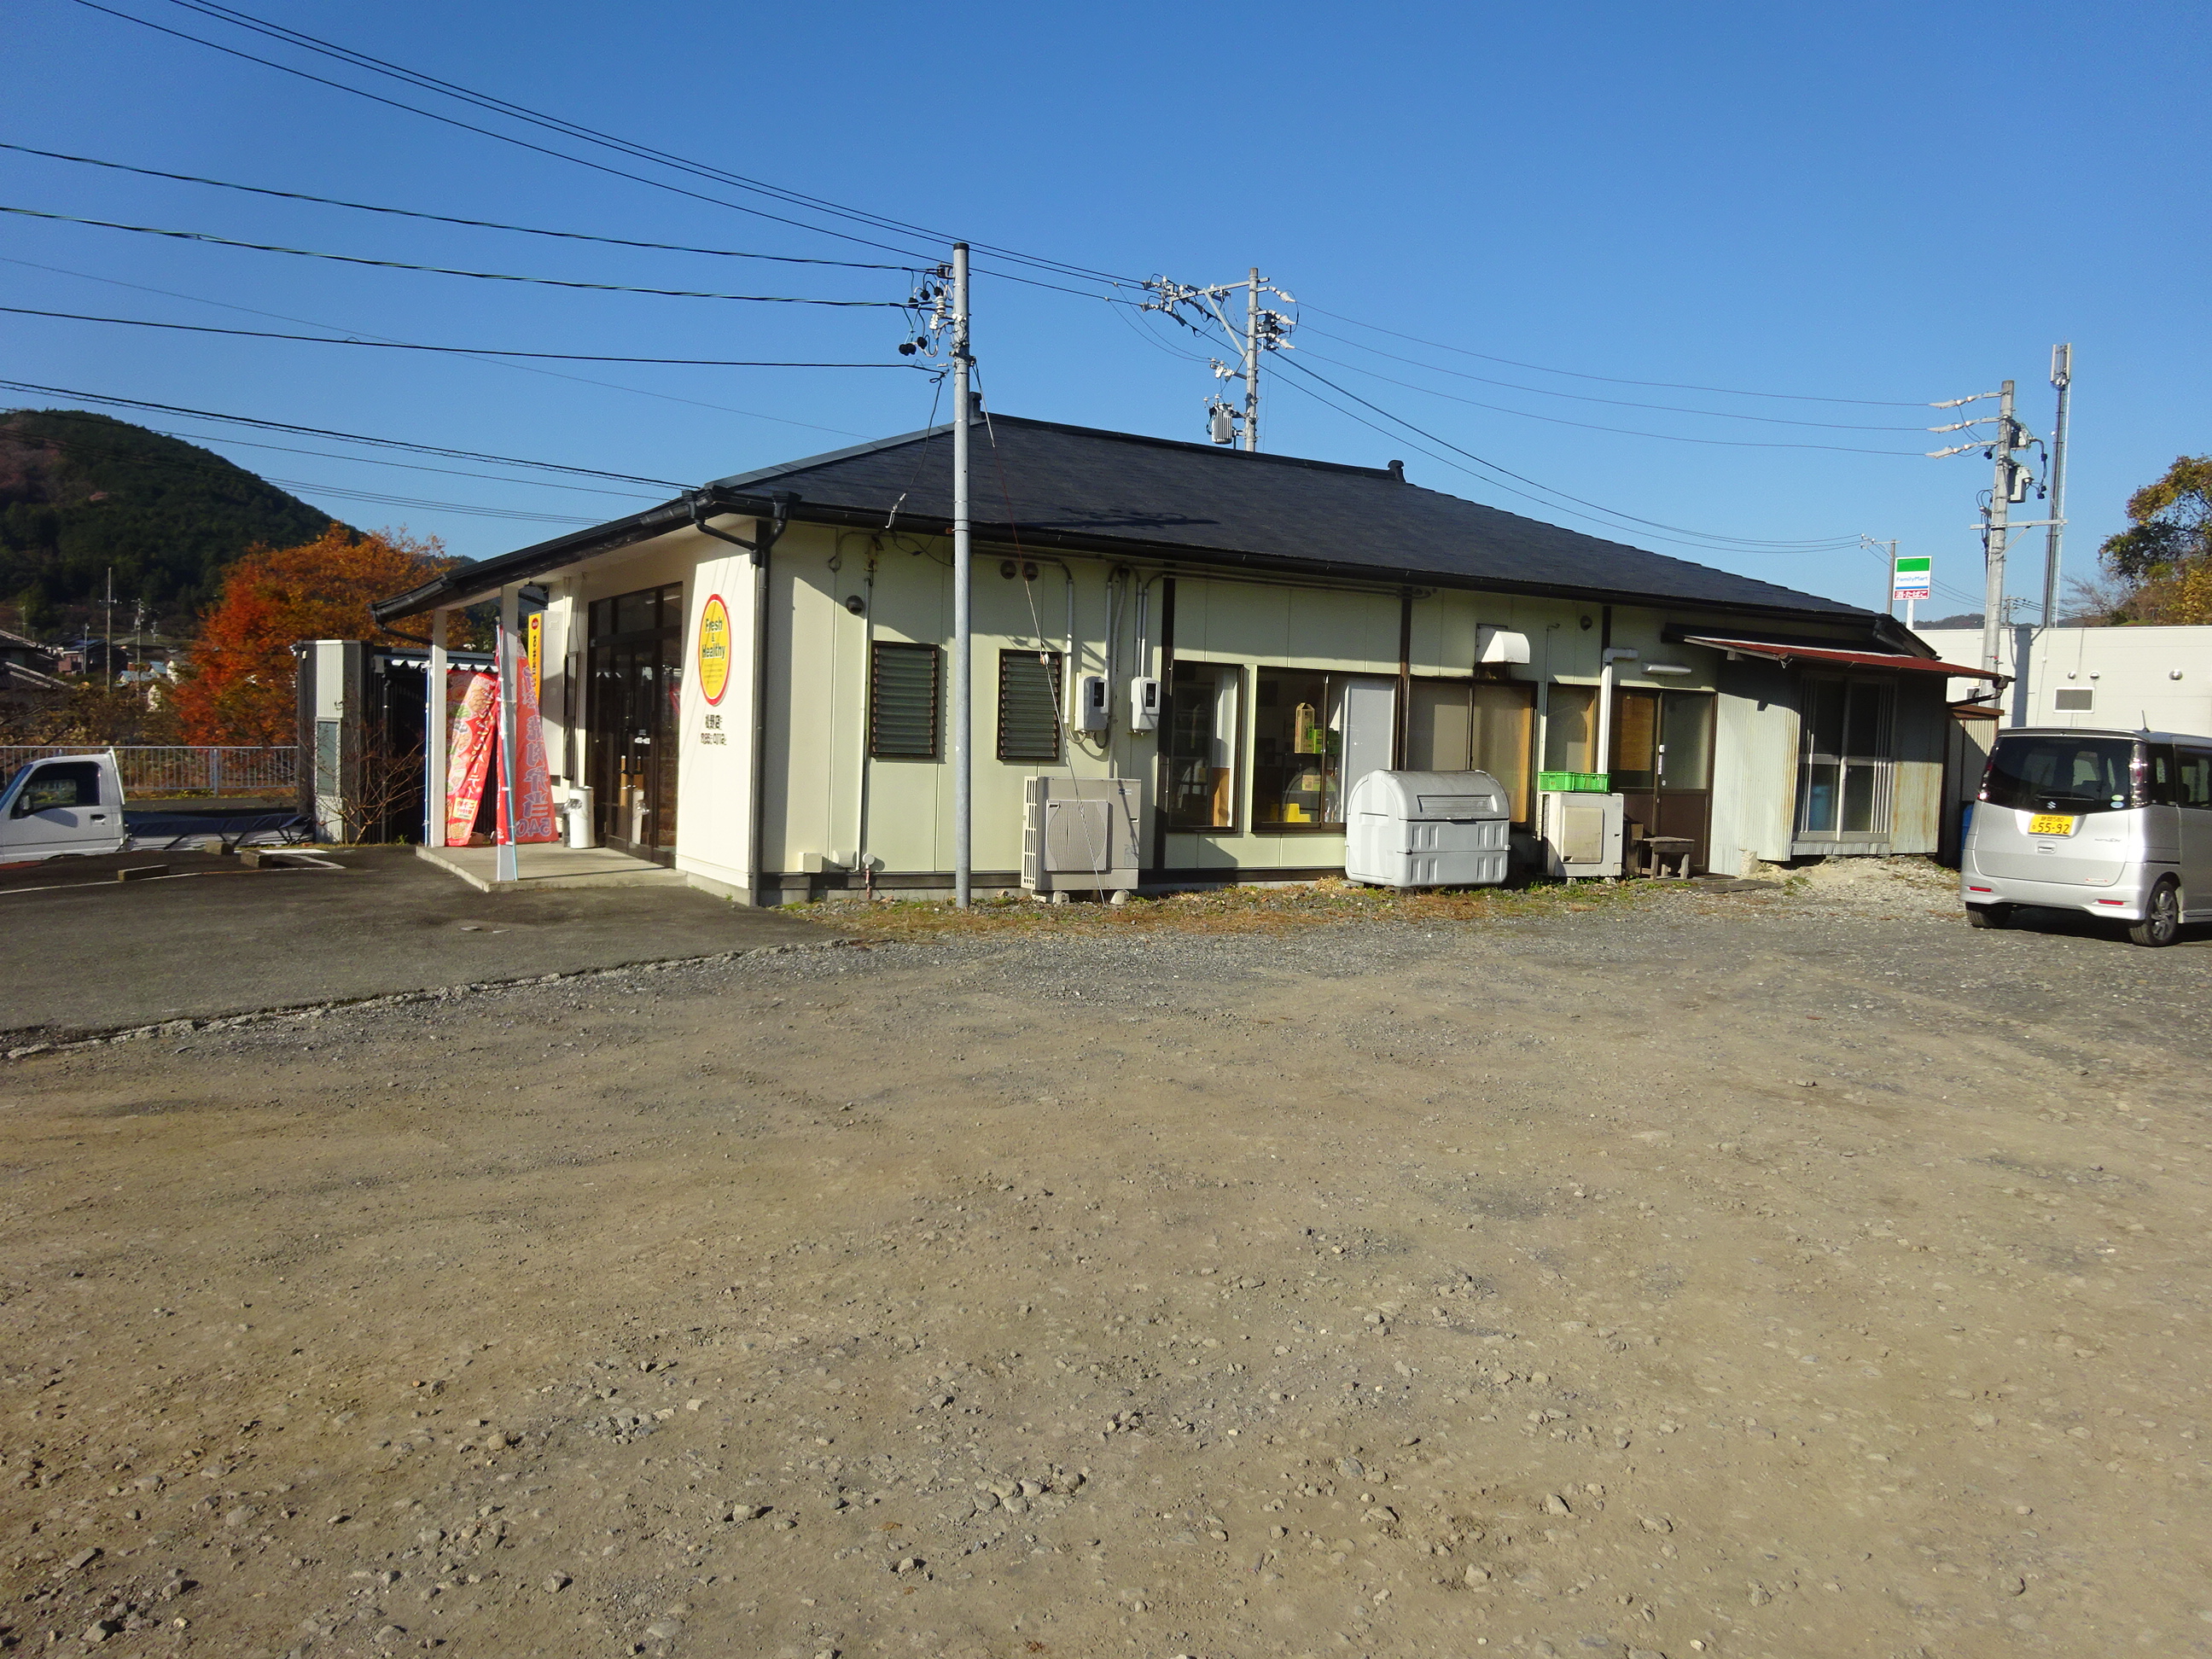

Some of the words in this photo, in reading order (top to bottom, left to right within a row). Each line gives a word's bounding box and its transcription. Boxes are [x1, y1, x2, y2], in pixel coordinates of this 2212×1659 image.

[705, 618, 723, 633] Fresh
[701, 643, 726, 661] Healthy
[2037, 823, 2070, 834] 55-92
